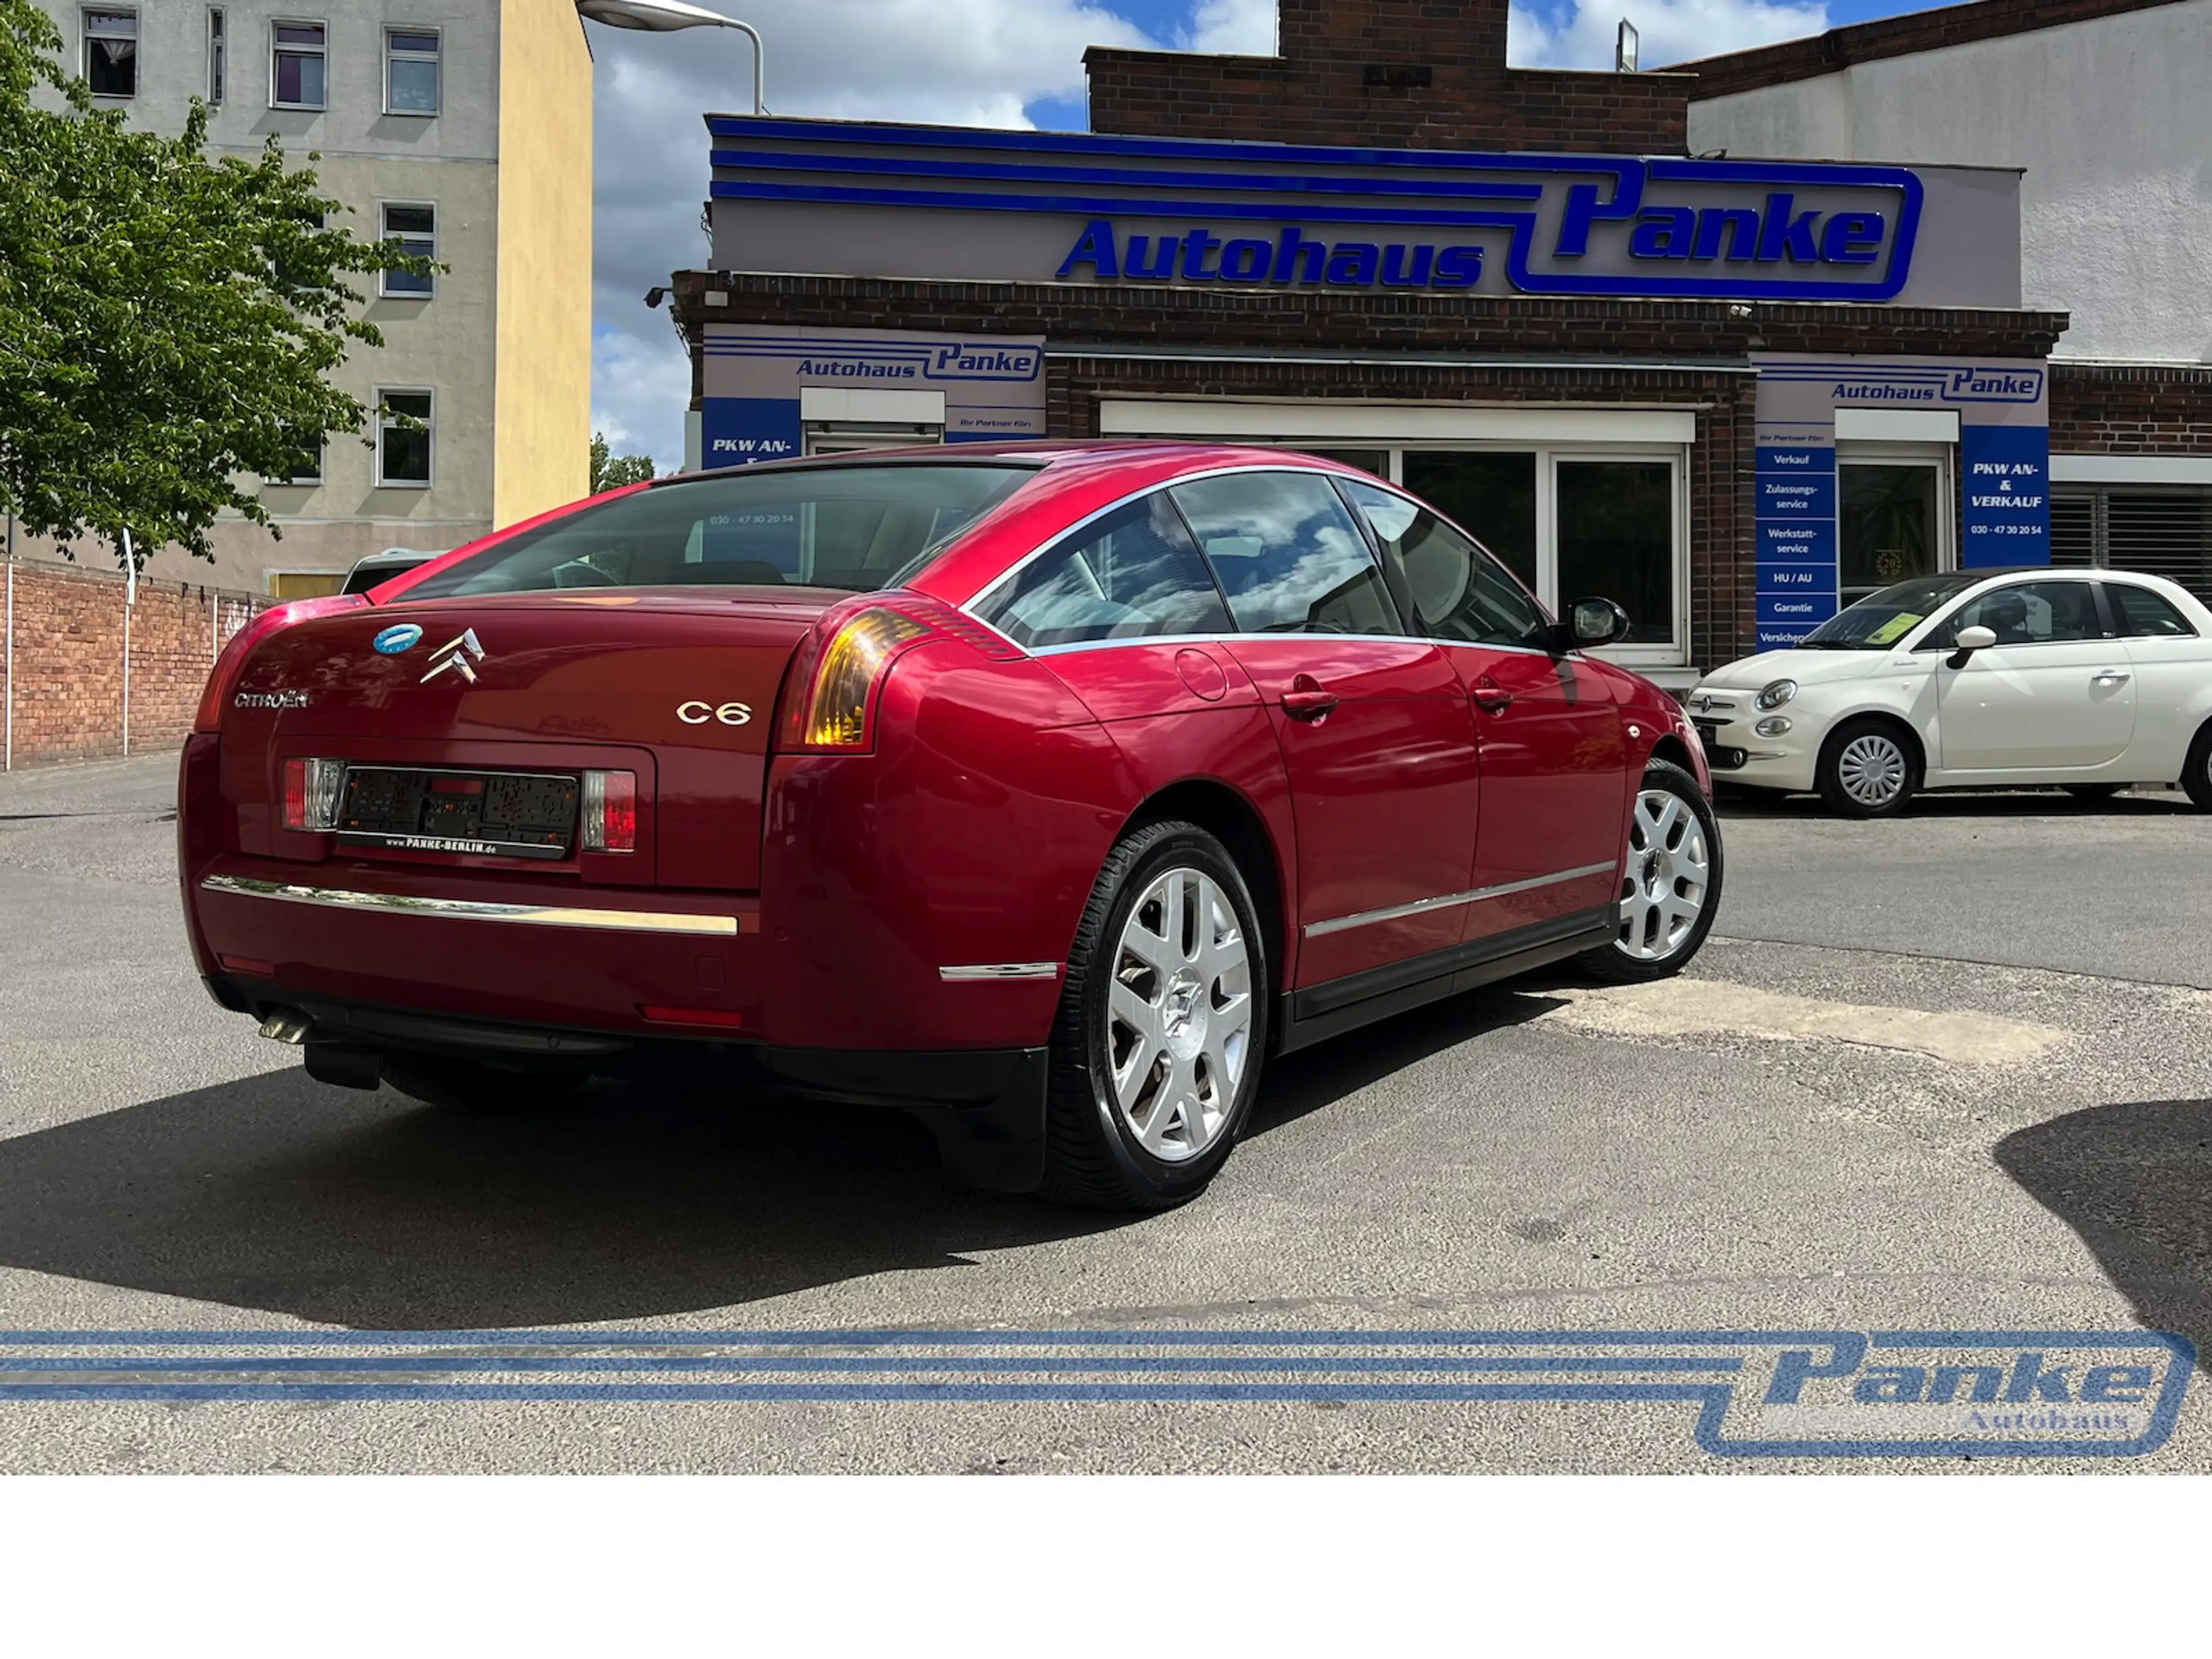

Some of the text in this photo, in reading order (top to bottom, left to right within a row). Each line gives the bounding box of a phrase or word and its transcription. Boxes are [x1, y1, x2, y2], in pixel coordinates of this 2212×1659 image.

[1056, 157, 1885, 289] Autohaus Panke
[797, 344, 1032, 379] Autohaus Panke
[1832, 369, 2035, 401] Autohaus Panke
[976, 419, 1012, 427] Partner
[713, 439, 791, 452] PKW AN-
[1774, 455, 1810, 464] Verkauf
[1972, 463, 2039, 475] PKW AN-
[1765, 484, 1819, 496] Zulassungs-
[1999, 479, 2012, 491] &
[1776, 499, 1808, 509] service
[1971, 496, 2042, 507] VERKAUF
[710, 517, 729, 525] 030
[1768, 528, 1817, 539] Werkstatt-
[1971, 525, 1987, 535] 030
[1994, 525, 2005, 535] 47
[2007, 525, 2018, 535] 30
[2019, 525, 2029, 535] 20
[2031, 525, 2041, 535] 54
[1777, 543, 1809, 554] service
[1774, 573, 1789, 583] HU
[1797, 573, 1812, 583] AU
[1774, 602, 1813, 613] Garantie
[234, 690, 308, 708] CITROËN
[676, 701, 752, 725] C6
[386, 838, 497, 854] www.PANKE-BERLIN.de
